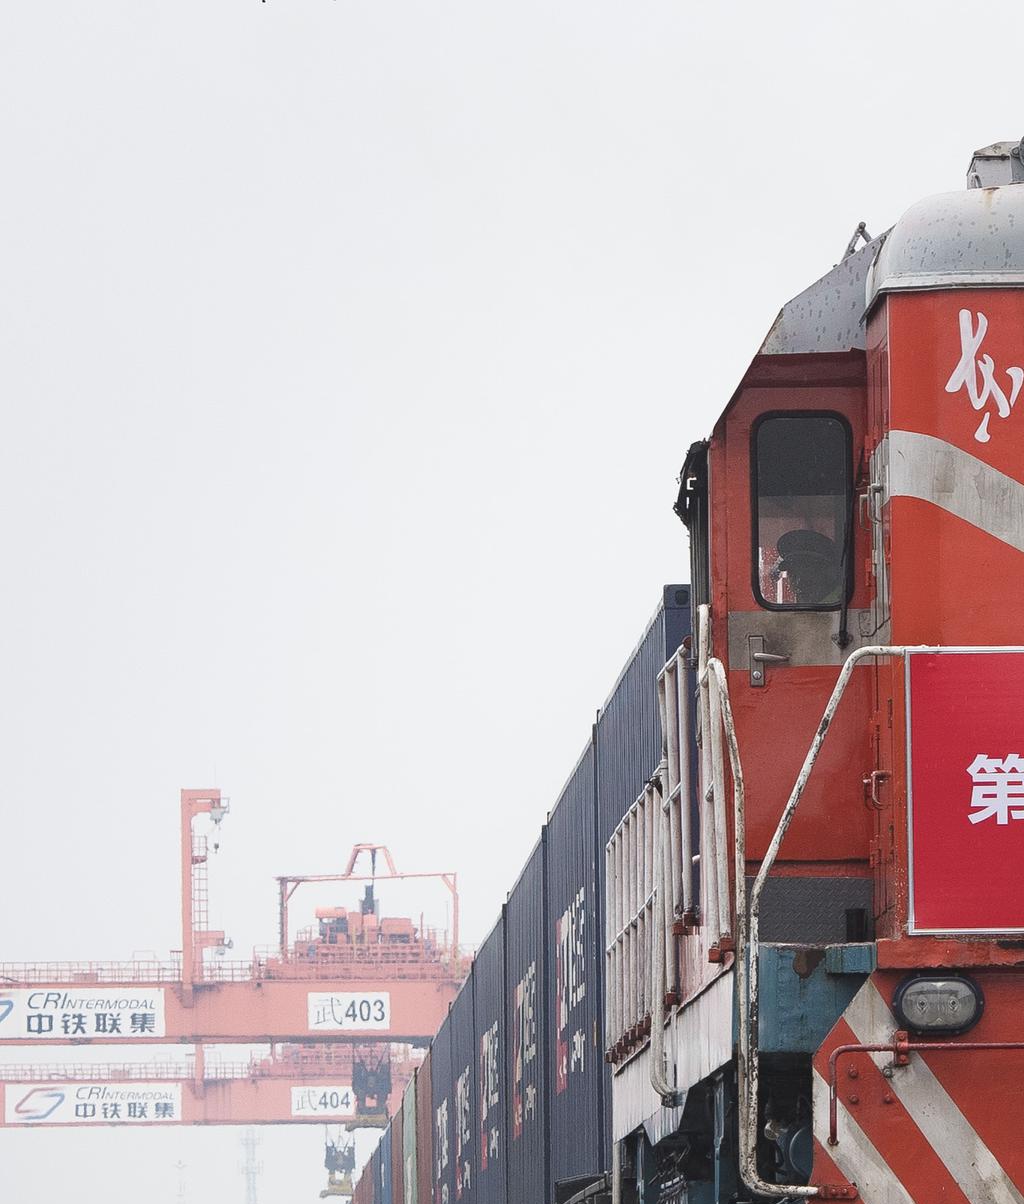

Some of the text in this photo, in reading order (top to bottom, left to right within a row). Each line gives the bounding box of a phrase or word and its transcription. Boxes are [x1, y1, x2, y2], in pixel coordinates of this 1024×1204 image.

[26, 1012, 156, 1035] 中铁联集
[75, 1101, 175, 1119] 中铁联集
